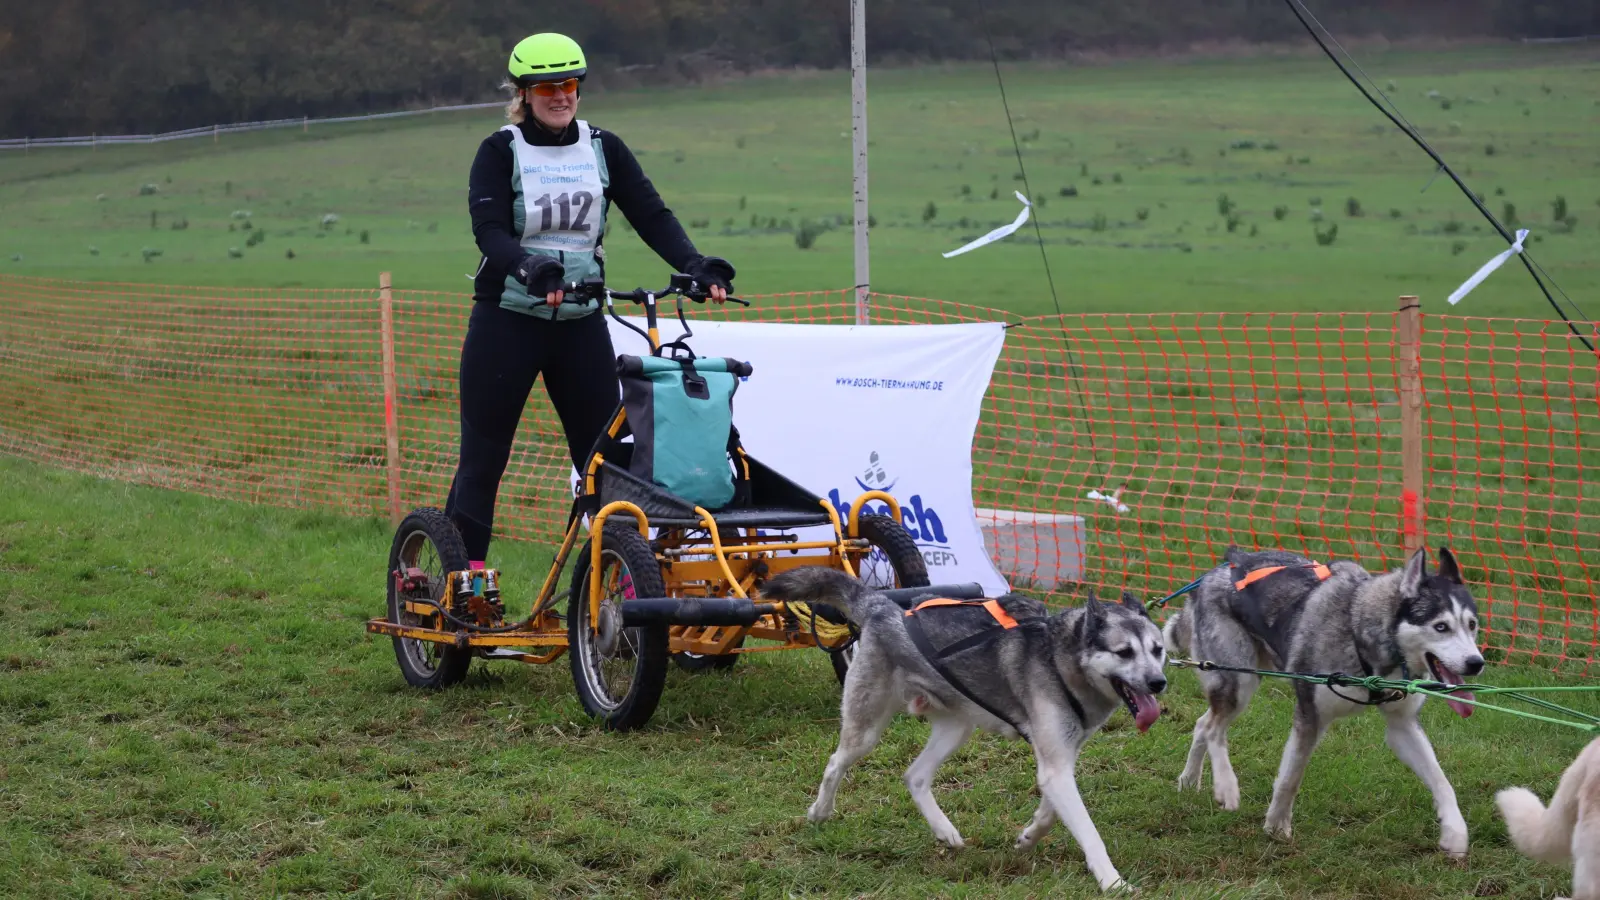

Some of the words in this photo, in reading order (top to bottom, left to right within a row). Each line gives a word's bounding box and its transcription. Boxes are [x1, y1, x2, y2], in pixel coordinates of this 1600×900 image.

[523, 165, 542, 174] Sled
[544, 165, 560, 173] Dog
[563, 162, 594, 172] Friends
[534, 190, 593, 231] 112
[828, 488, 948, 544] bch
[920, 551, 958, 566] CEPT
